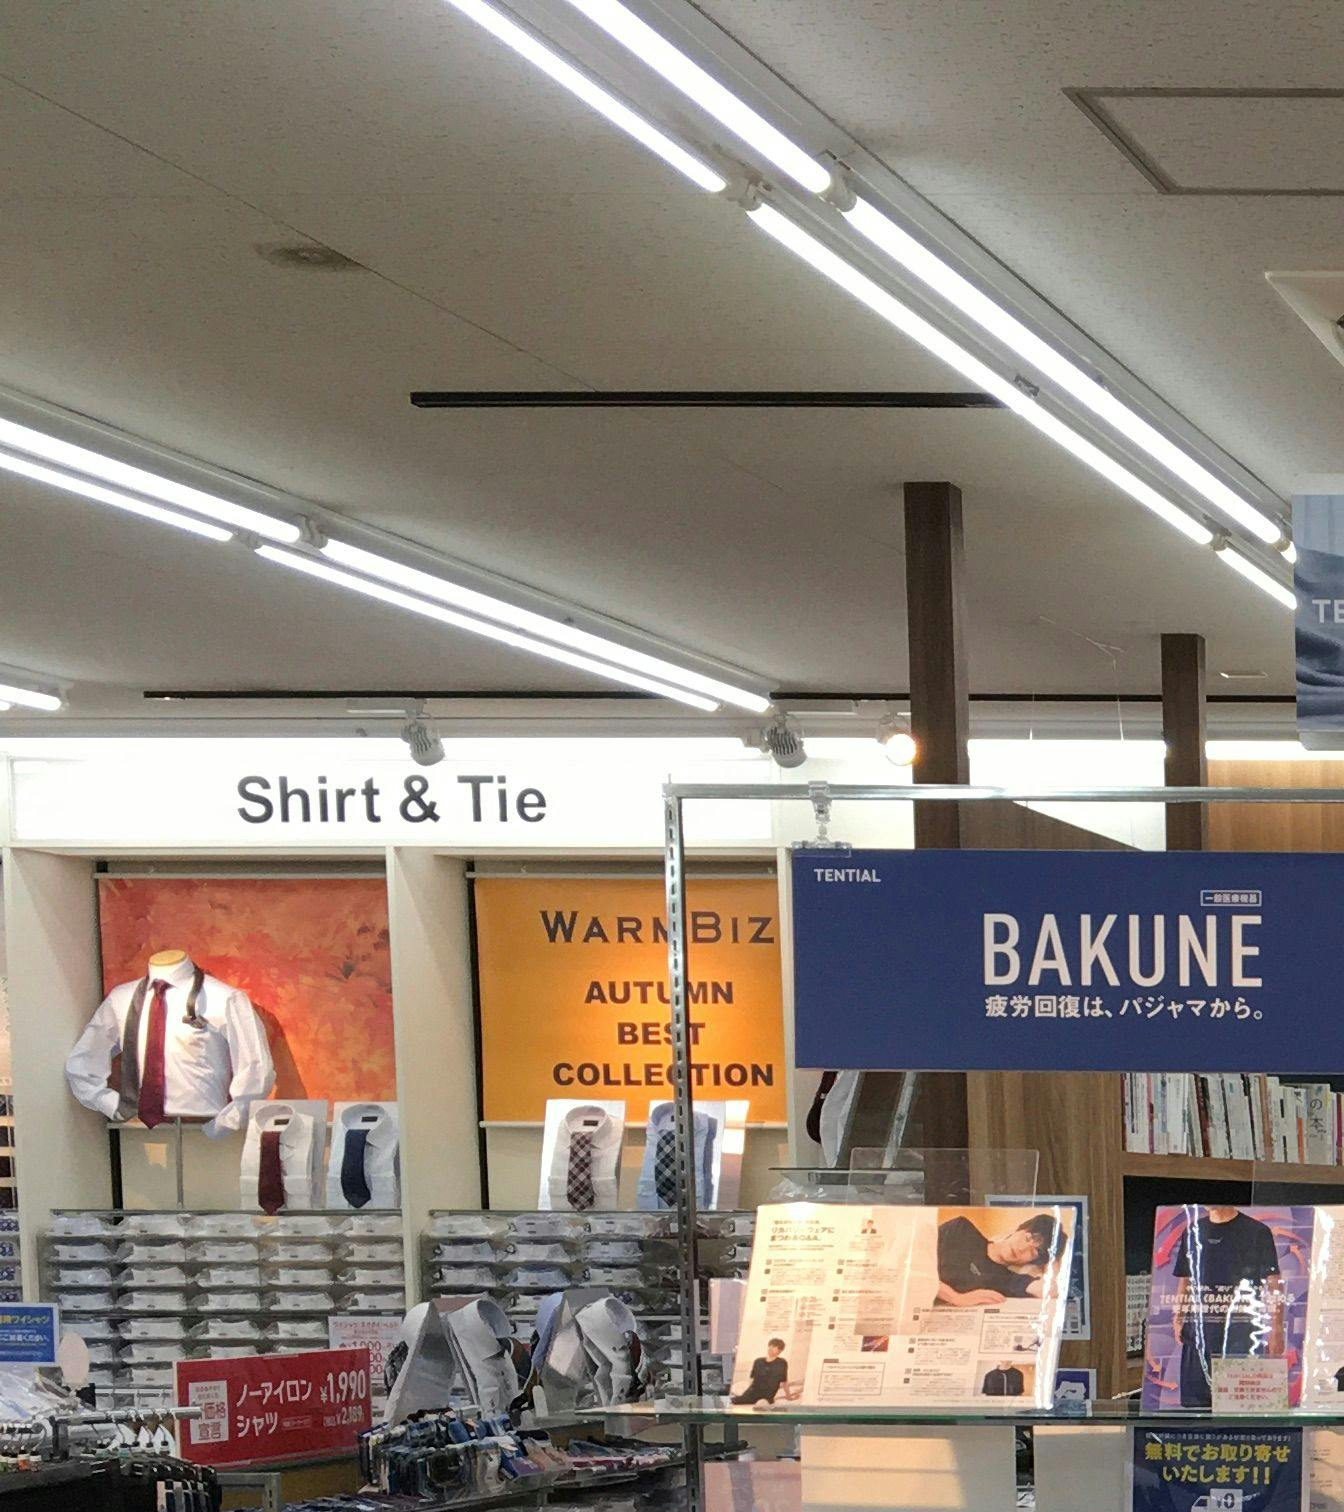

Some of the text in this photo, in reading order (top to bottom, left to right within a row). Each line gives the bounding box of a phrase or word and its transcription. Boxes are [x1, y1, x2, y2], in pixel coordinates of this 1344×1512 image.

[237, 774, 546, 823] Shirt & Tie
[813, 868, 881, 883] TENTIAL
[983, 913, 1263, 987] BAKUNE
[584, 981, 733, 1004] AUTUMN
[985, 994, 1263, 1020] 疲労回復は、パジャマから。
[236, 1379, 312, 1407] ノーアイロン
[320, 1368, 367, 1404] ¥1,990
[236, 1411, 279, 1438] シャツ
[1145, 1442, 1291, 1463] 無料でお取り寄せ
